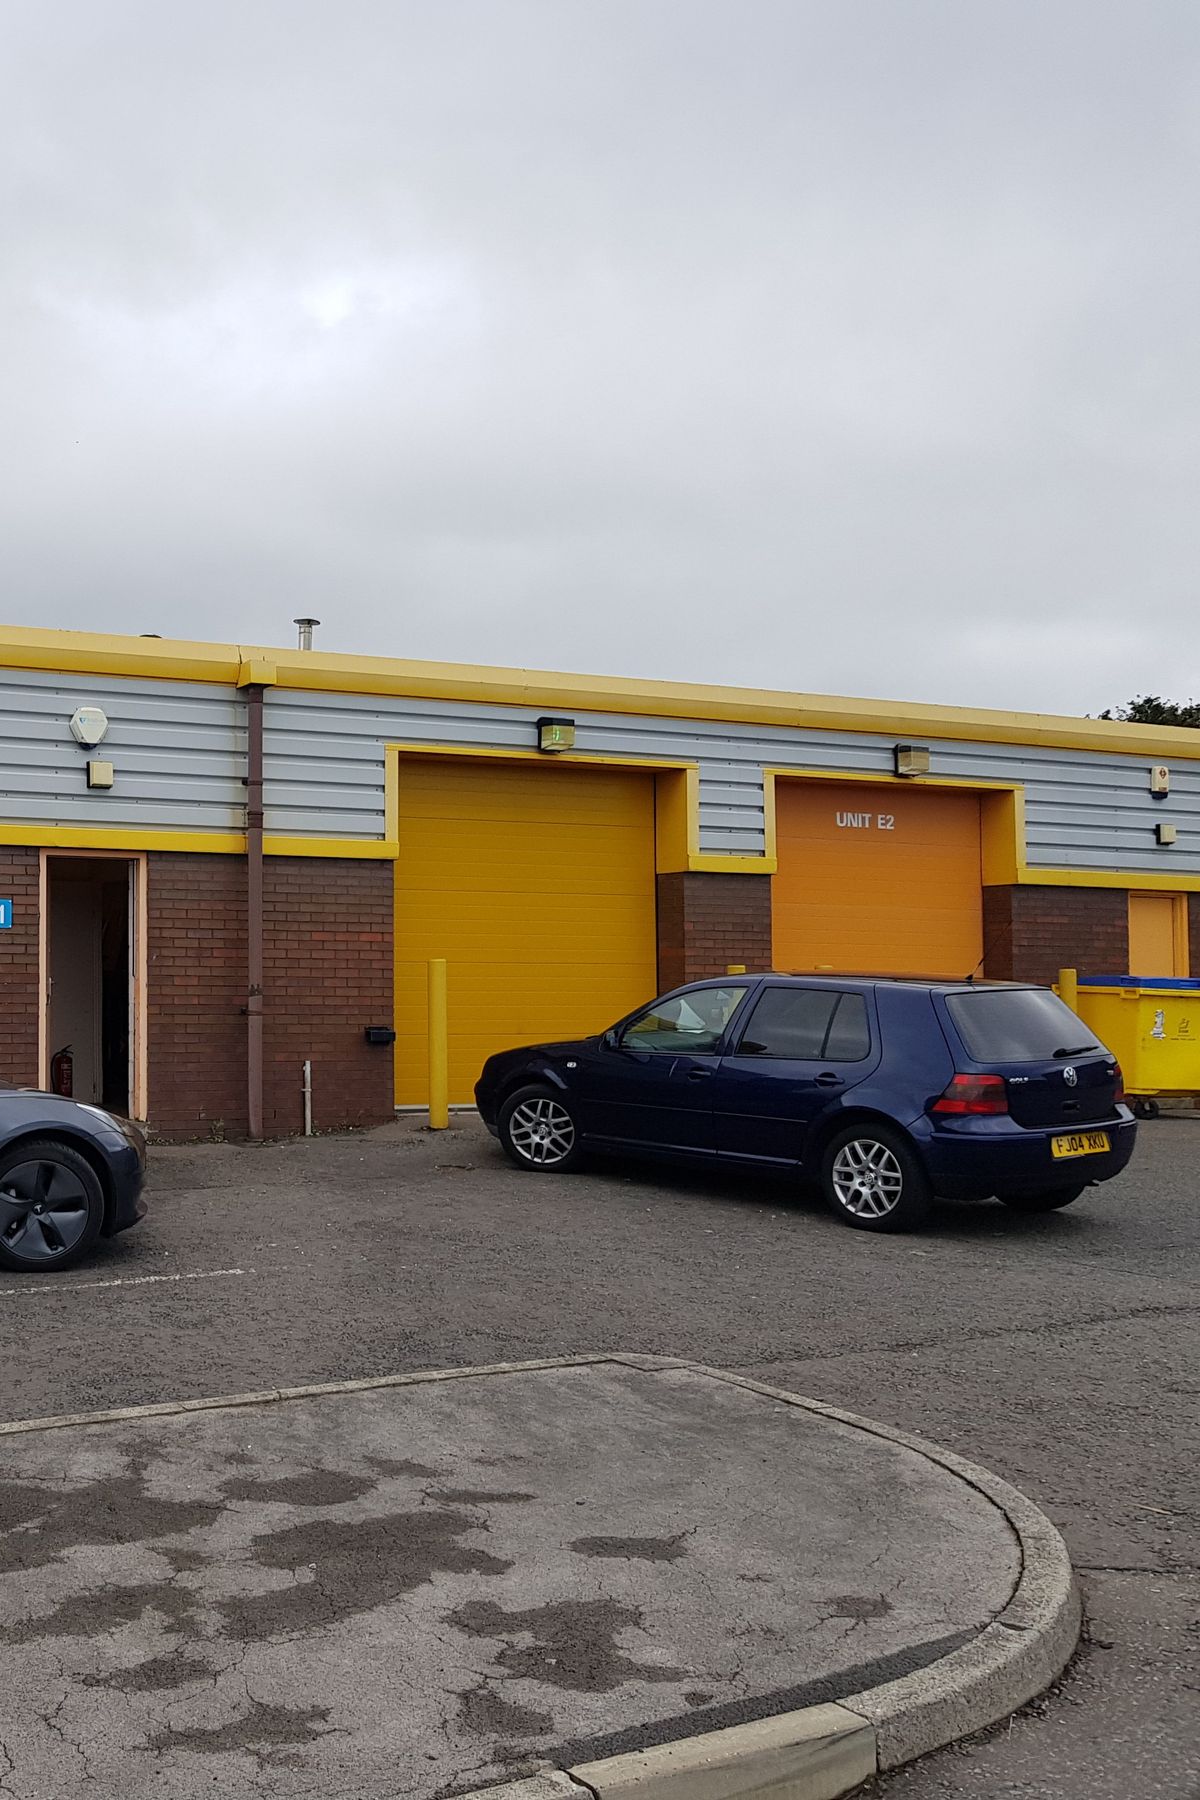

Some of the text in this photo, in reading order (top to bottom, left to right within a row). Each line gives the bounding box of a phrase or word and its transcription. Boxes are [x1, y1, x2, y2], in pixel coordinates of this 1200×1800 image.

[835, 811, 895, 830] UNIT E2
[1056, 1135, 1085, 1154] FJ04
